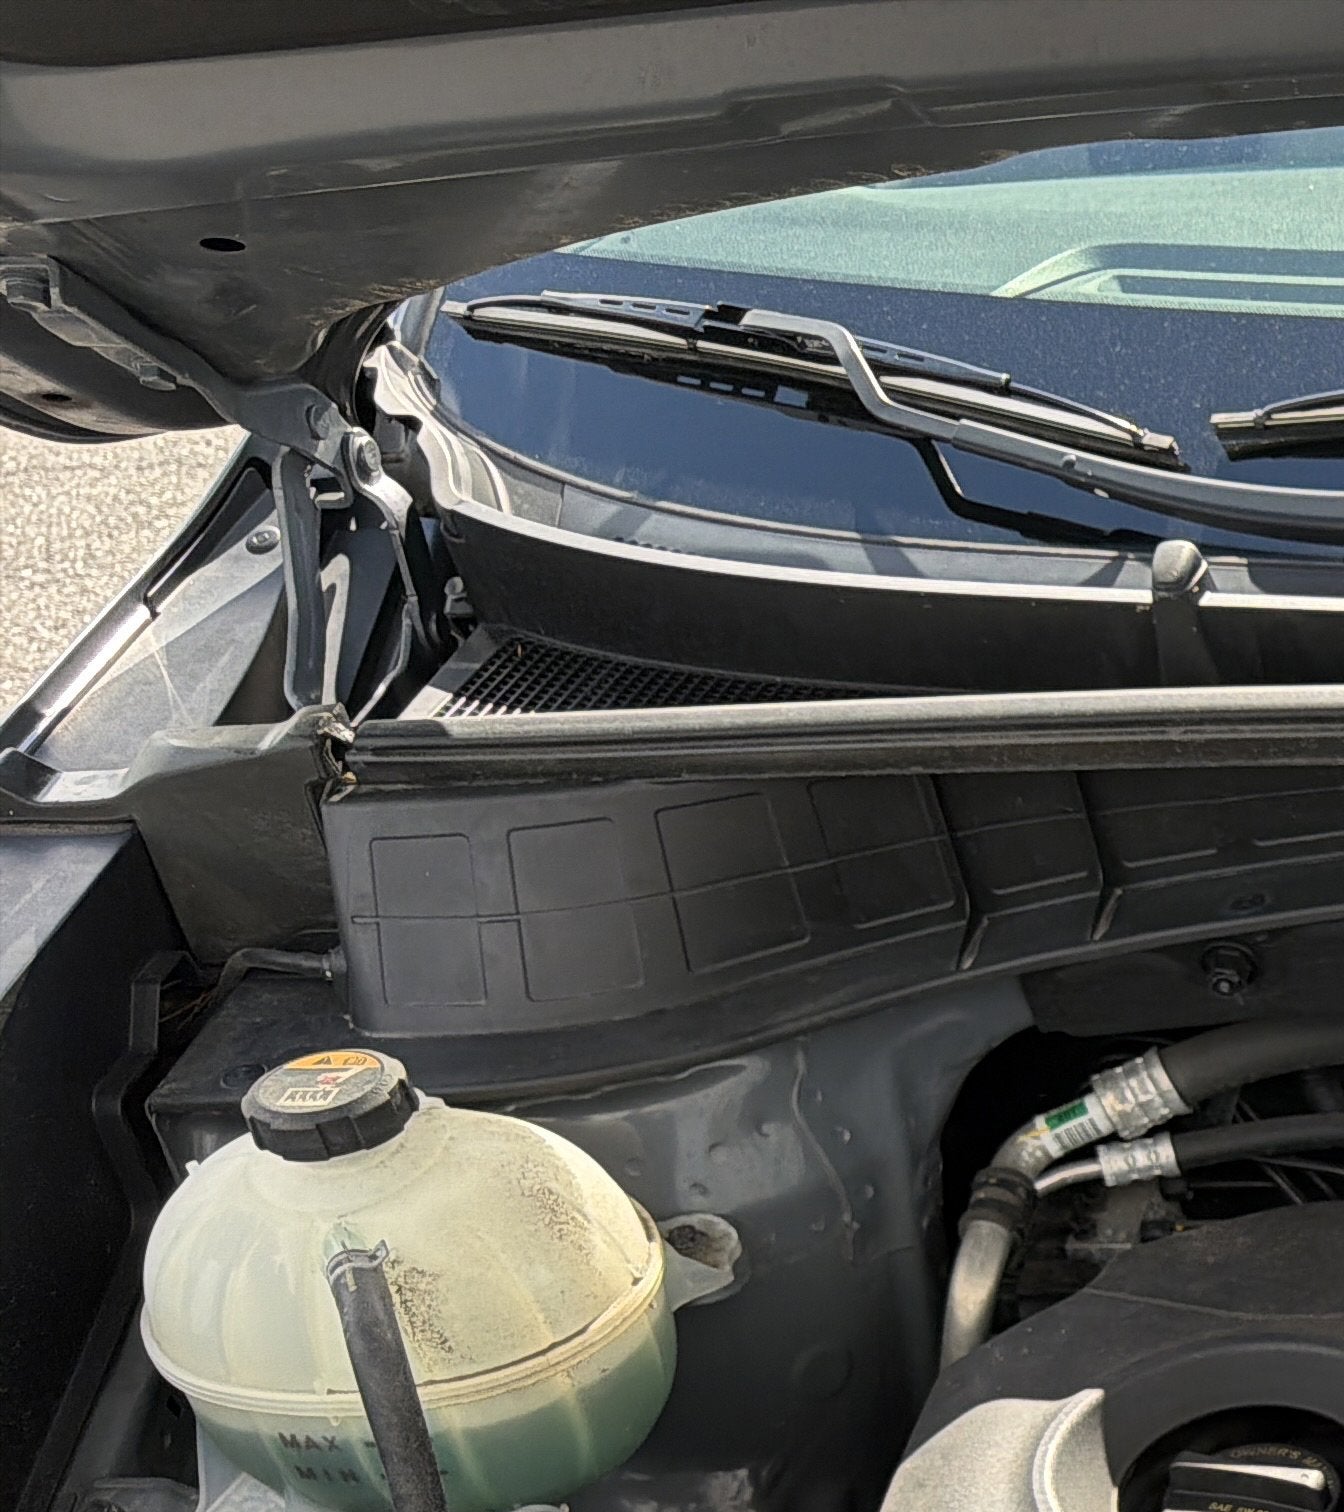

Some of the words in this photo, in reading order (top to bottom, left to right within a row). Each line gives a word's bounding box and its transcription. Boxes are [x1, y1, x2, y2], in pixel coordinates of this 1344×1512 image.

[278, 1432, 340, 1451] MAX
[294, 1465, 361, 1483] MIN
[1208, 1501, 1232, 1512] SAE
